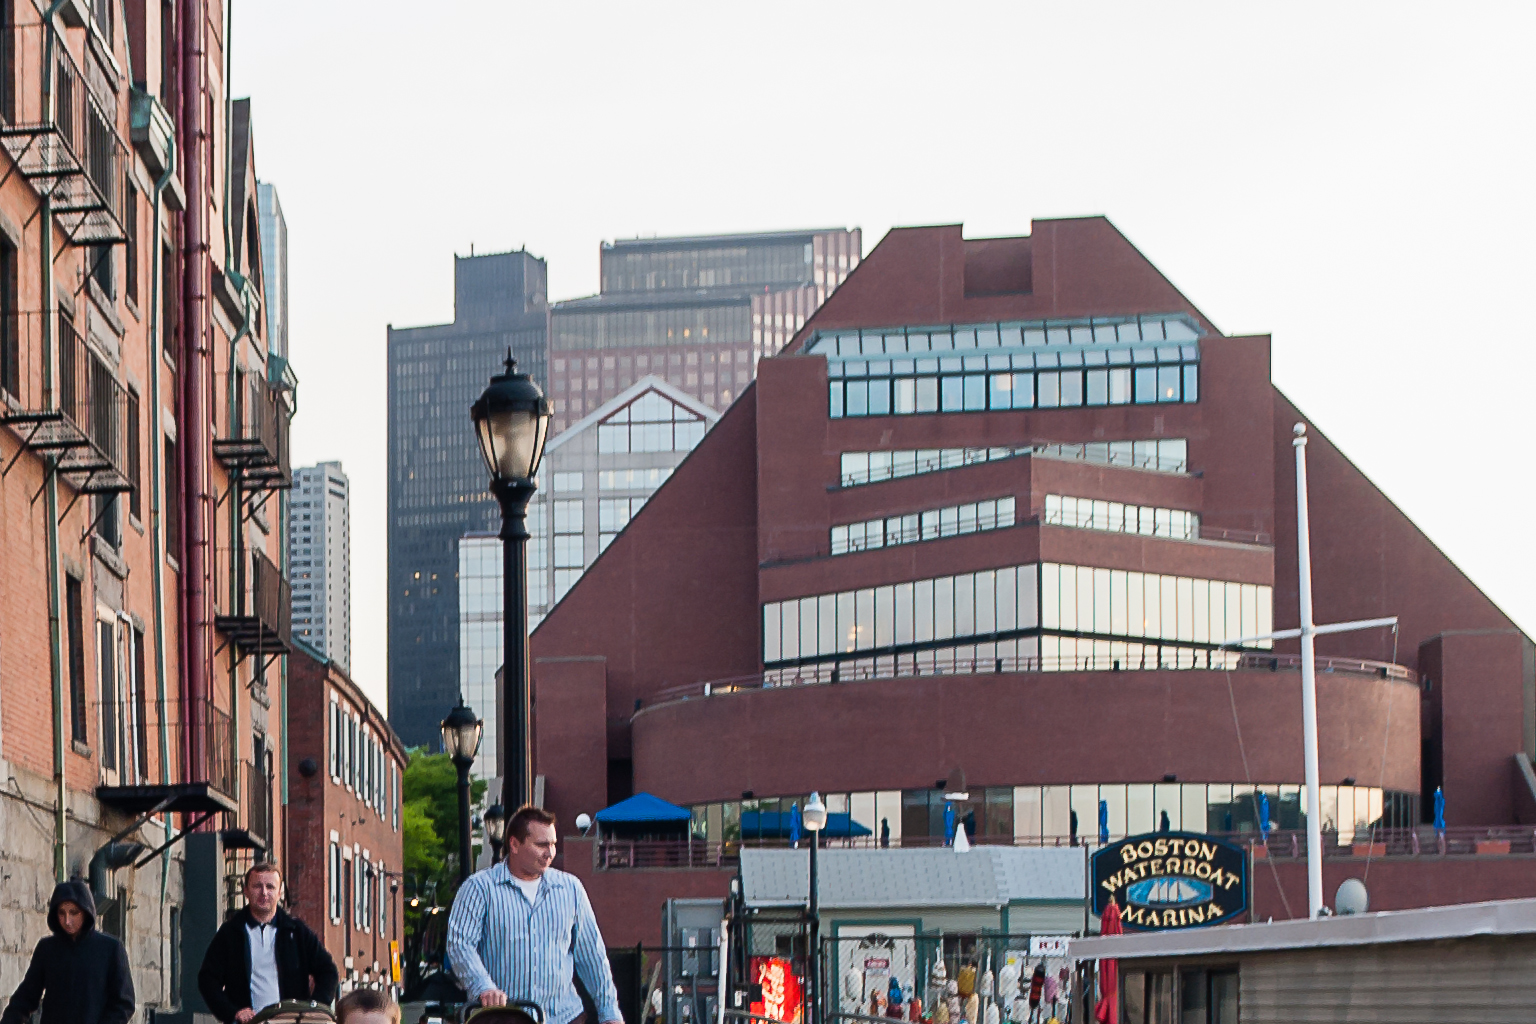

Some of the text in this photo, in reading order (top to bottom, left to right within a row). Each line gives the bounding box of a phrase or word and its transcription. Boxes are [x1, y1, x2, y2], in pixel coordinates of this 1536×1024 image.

[1120, 838, 1218, 864] BOSTON
[1101, 857, 1240, 893] WATERBOAT
[1120, 903, 1224, 927] MARINA
